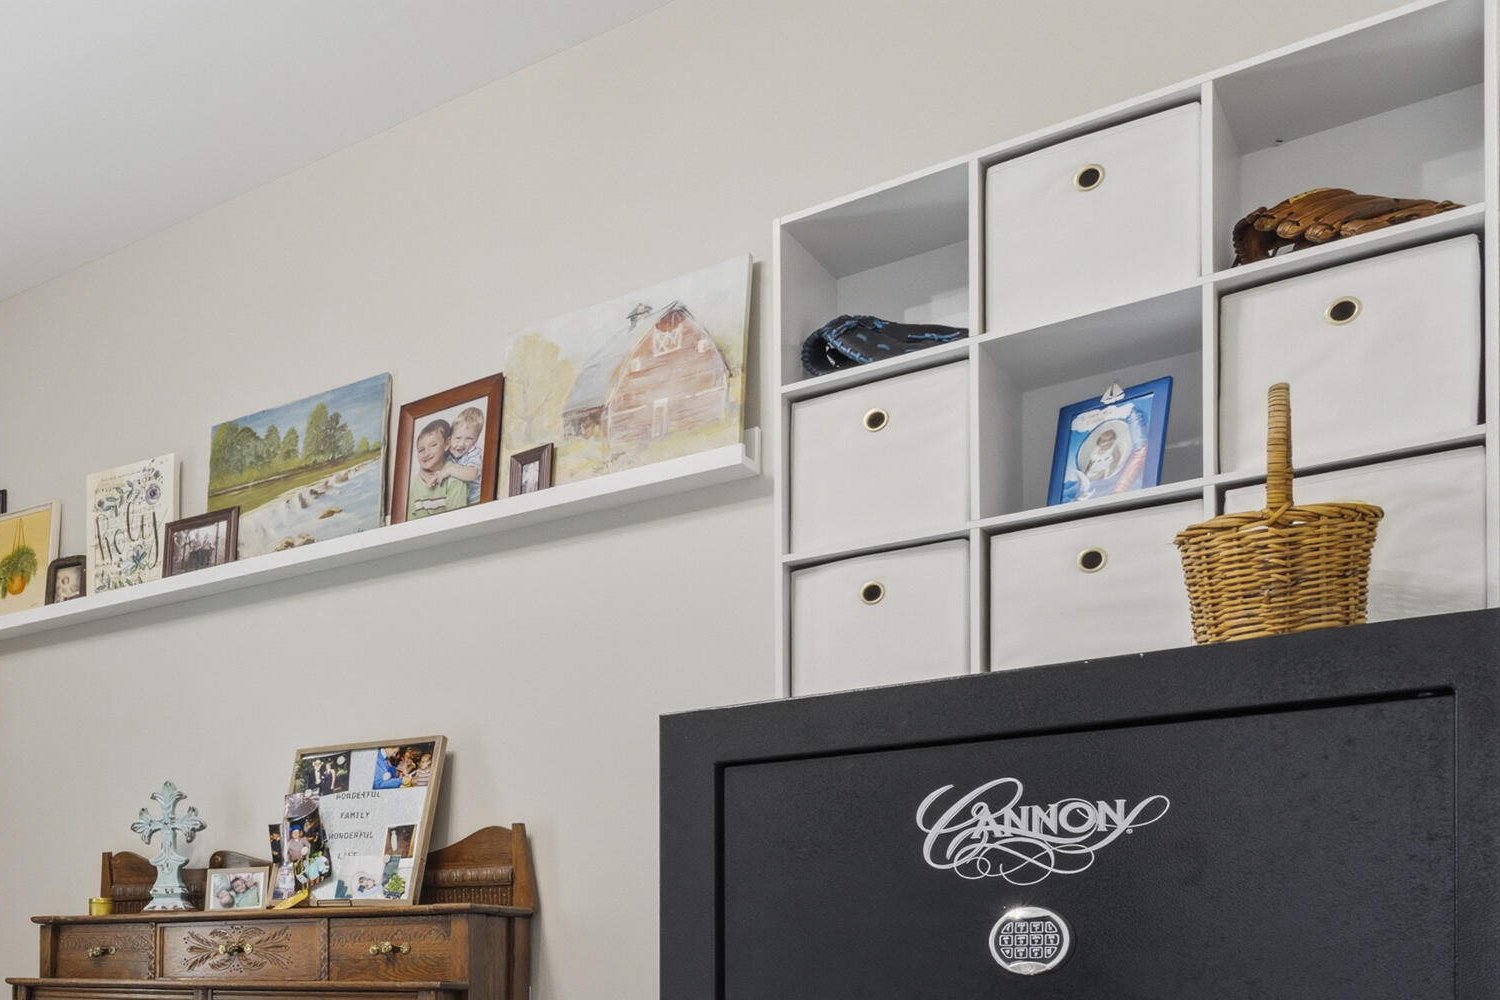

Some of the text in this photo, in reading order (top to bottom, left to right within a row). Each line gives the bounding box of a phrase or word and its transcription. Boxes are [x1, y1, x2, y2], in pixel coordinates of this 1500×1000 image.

[335, 790, 381, 800] WONDERFUL
[340, 811, 370, 819] FAMILY
[328, 831, 374, 841] WONDERFUL
